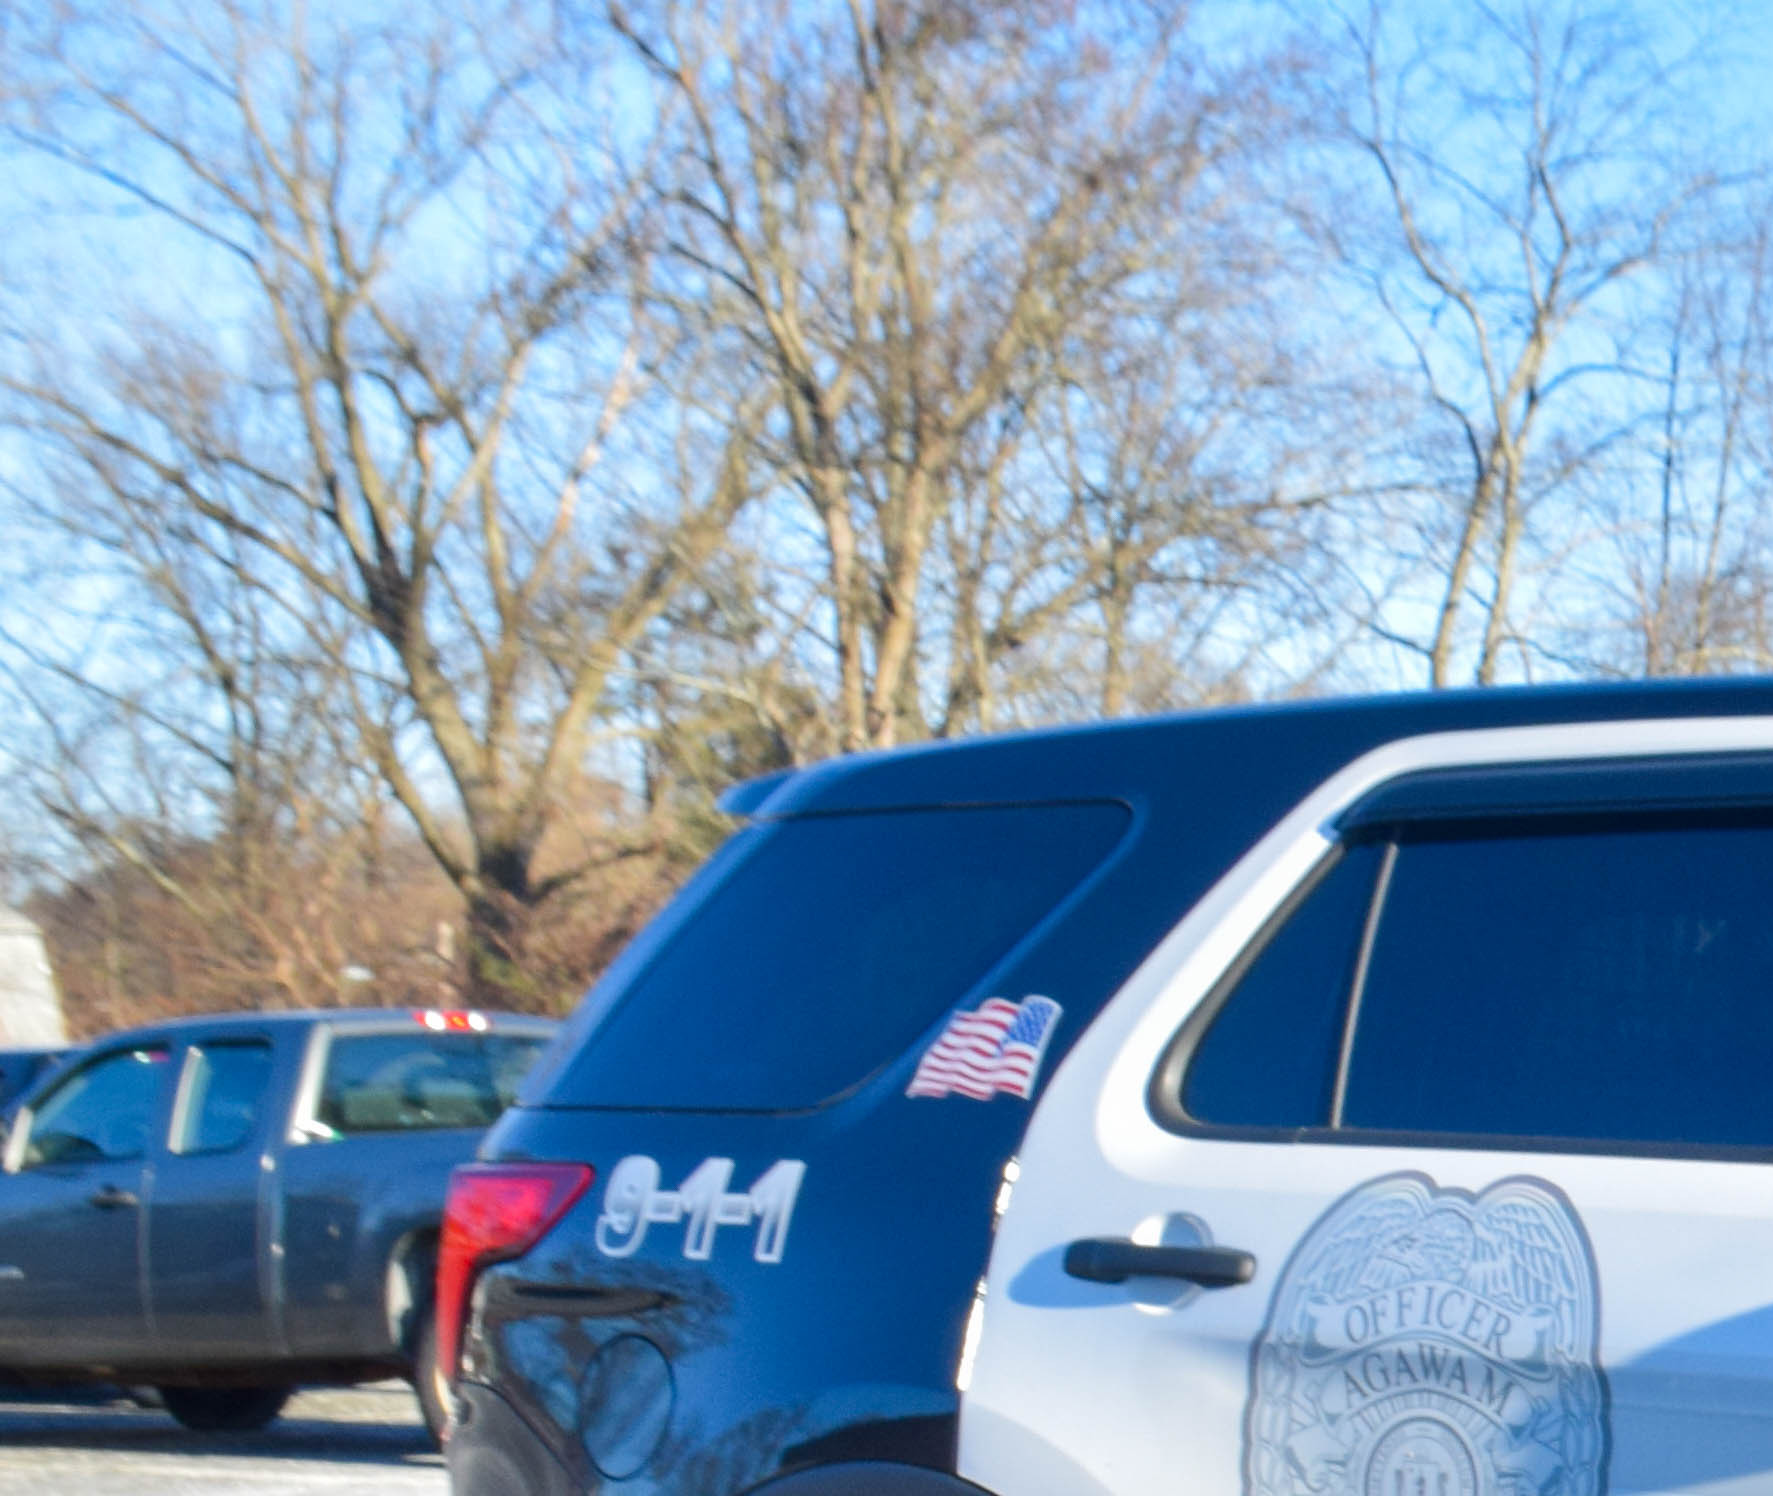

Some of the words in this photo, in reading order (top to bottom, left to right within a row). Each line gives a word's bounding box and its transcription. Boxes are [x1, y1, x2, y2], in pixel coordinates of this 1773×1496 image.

[594, 1154, 808, 1264] 9-1-1
[1343, 1286, 1513, 1350] OFFICER
[1342, 1340, 1516, 1415] AGAWAM
